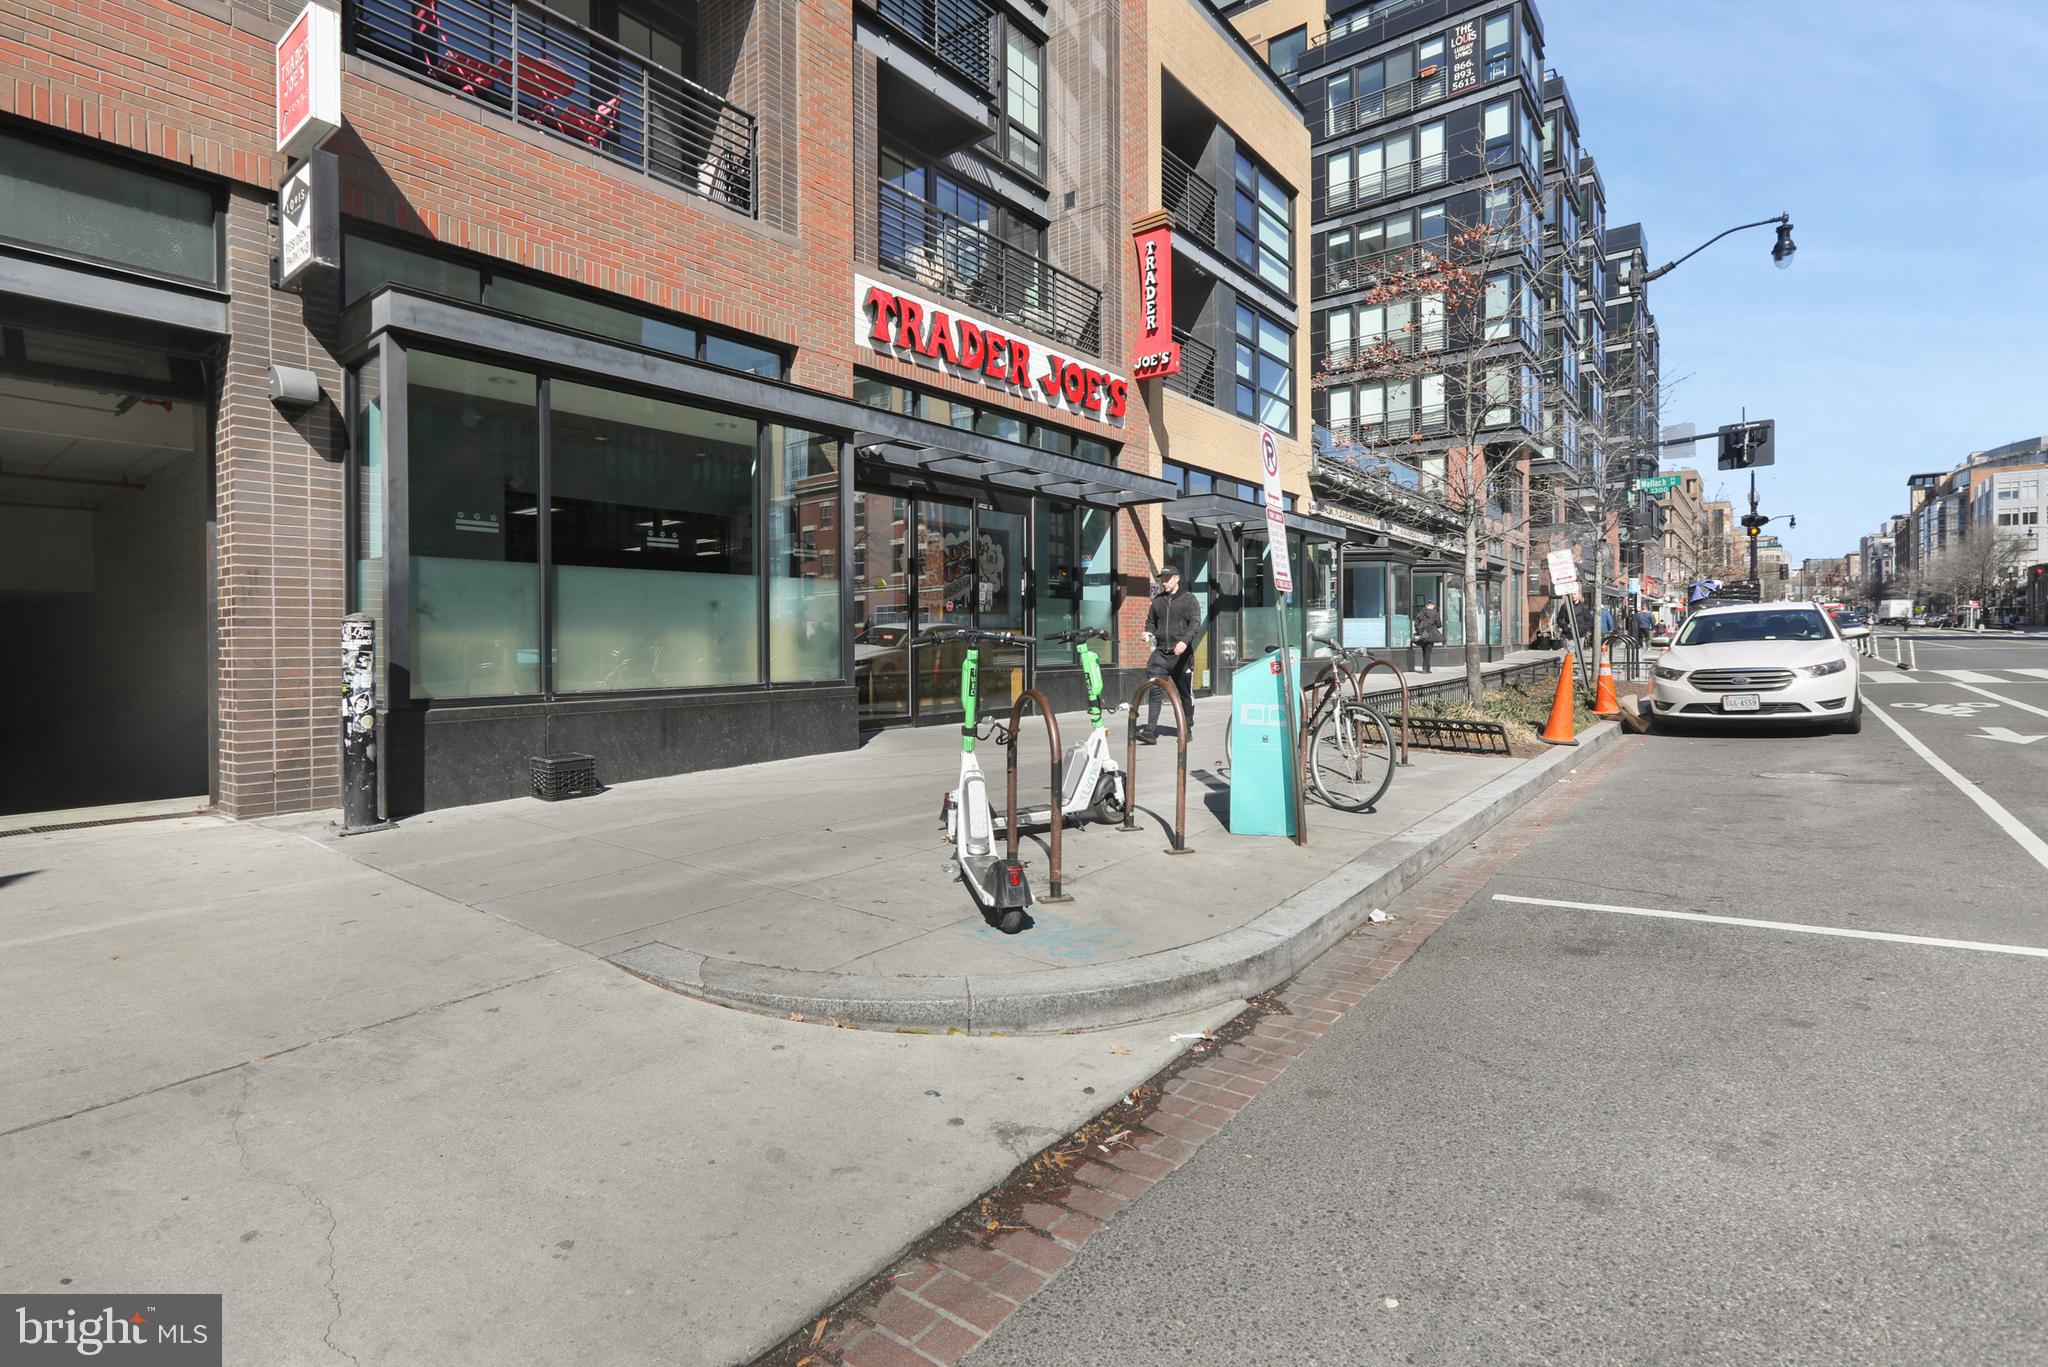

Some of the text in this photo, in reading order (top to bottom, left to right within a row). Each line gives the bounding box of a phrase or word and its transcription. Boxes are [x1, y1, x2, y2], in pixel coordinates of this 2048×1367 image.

[1455, 22, 1473, 36] THE
[1451, 30, 1477, 48] LOUIS
[281, 36, 309, 82] TRADER
[1454, 59, 1474, 72] 866.
[284, 61, 305, 97] JOE'S
[1452, 76, 1476, 90] 5615
[1454, 68, 1474, 80] 893.
[1145, 240, 1157, 330] TRADER
[867, 286, 1128, 418] TRADER JOE'S
[1134, 352, 1170, 370] JOE'S
